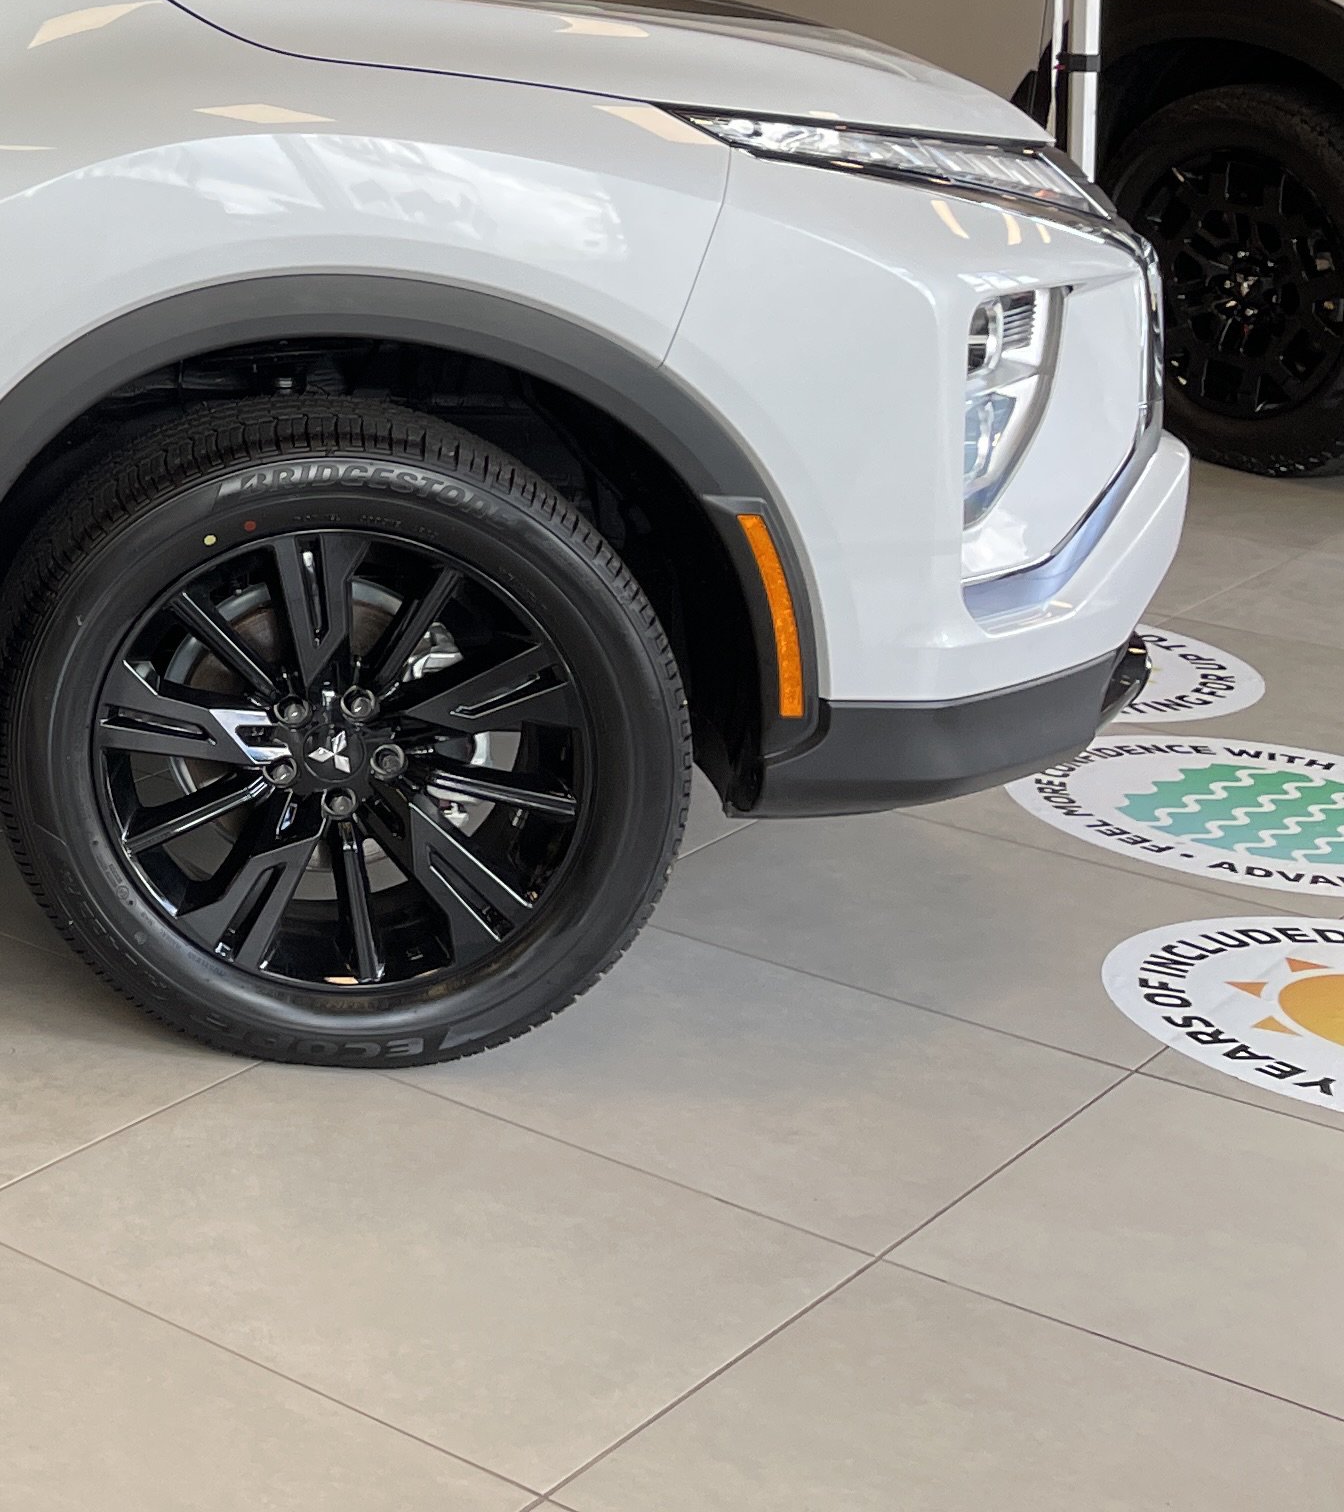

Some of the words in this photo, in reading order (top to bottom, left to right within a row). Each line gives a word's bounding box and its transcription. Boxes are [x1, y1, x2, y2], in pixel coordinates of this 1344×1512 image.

[1178, 652, 1227, 670] UP
[1198, 673, 1236, 699] FOR
[1223, 746, 1336, 771] WITH
[1034, 777, 1094, 818] MORE
[1085, 818, 1175, 854] FEEL
[1207, 860, 1344, 888] ADVA
[1139, 926, 1344, 980] INCLUDED
[1138, 977, 1192, 1008] OF
[1162, 1015, 1337, 1097] YEARS
